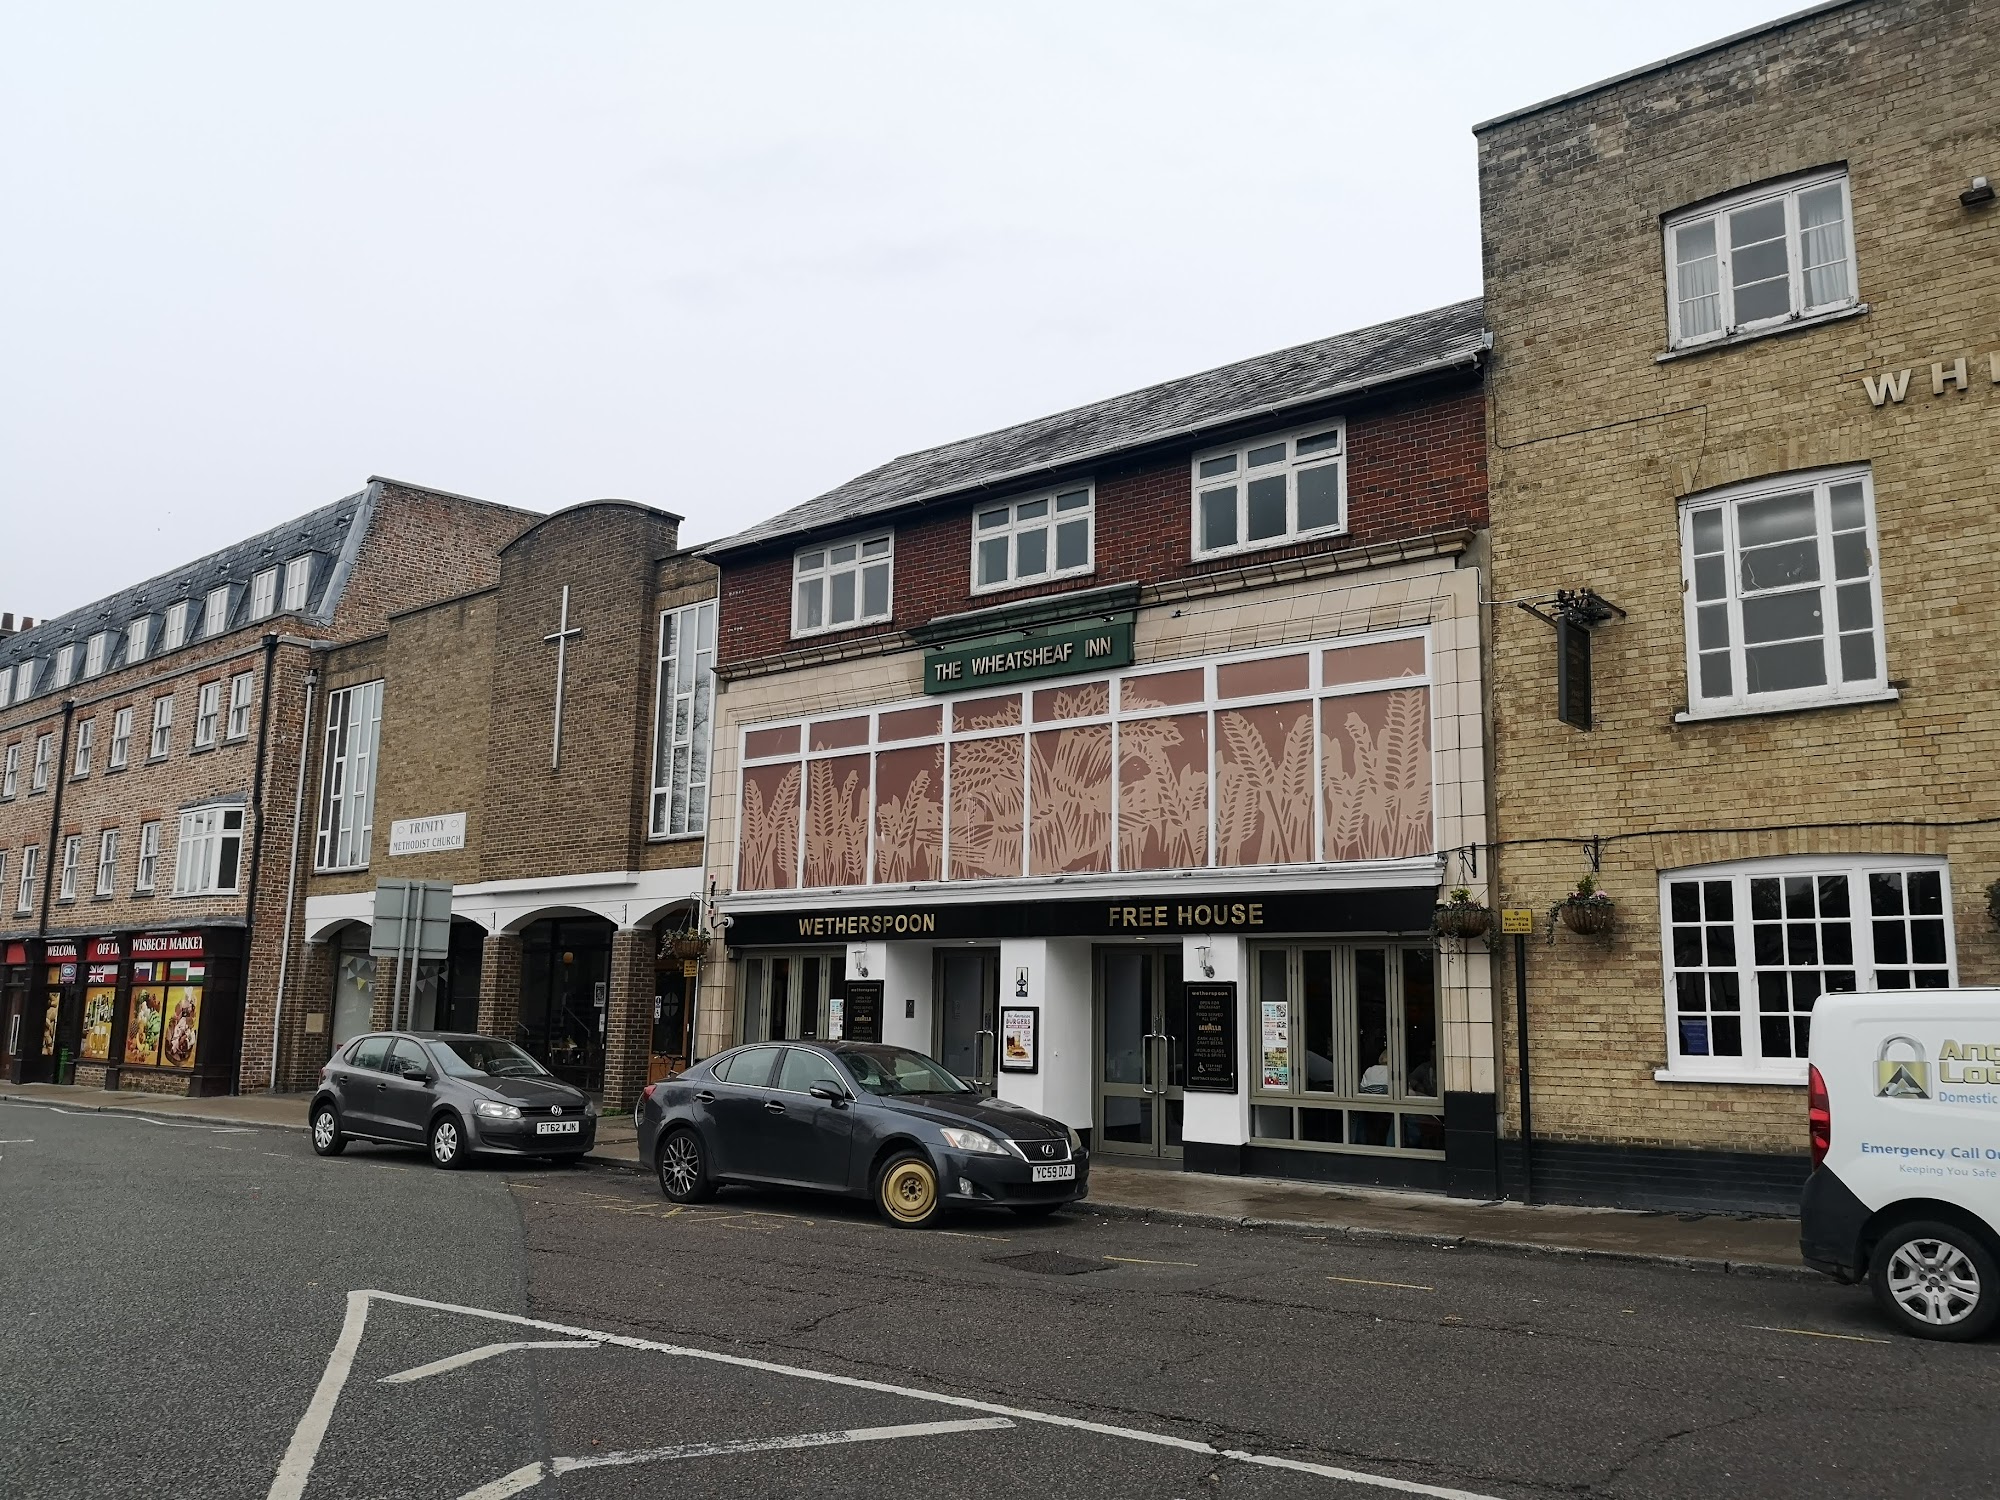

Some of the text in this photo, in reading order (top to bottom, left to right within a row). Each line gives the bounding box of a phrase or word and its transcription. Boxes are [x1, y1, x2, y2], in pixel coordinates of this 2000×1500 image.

[935, 636, 1112, 681] THE WHEATSHEAF INN
[409, 819, 446, 834] TRINITY
[393, 835, 461, 851] METHODIST CHURCH
[1109, 903, 1264, 927] FREE HOUSE
[798, 913, 935, 936] WETHERSPOON
[97, 942, 110, 955] OFF
[132, 937, 167, 951] WISBECH
[1938, 1091, 1998, 1104] Domestic
[540, 1123, 560, 1132] FT62
[1861, 1142, 1945, 1159] Emergency
[1951, 1147, 1980, 1159] Call
[1036, 1165, 1073, 1178] YC59 DZJ
[1899, 1164, 1997, 1178] Keeping You Safe
